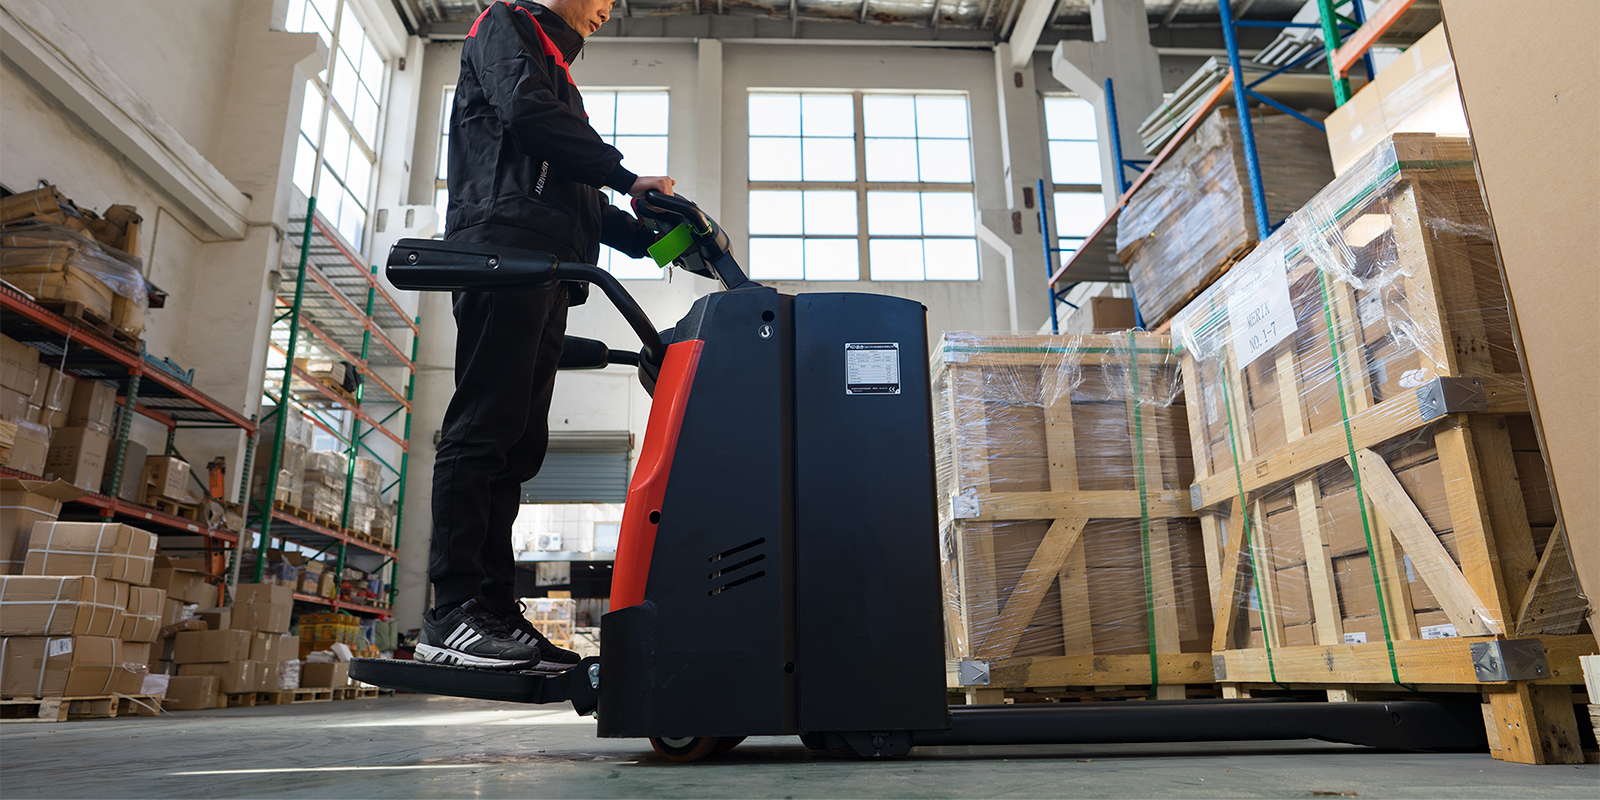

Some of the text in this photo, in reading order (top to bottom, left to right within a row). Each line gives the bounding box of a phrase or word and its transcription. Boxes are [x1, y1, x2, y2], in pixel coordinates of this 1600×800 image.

[1246, 300, 1270, 329] MERIK
[1249, 321, 1276, 353] NO. 1-7
